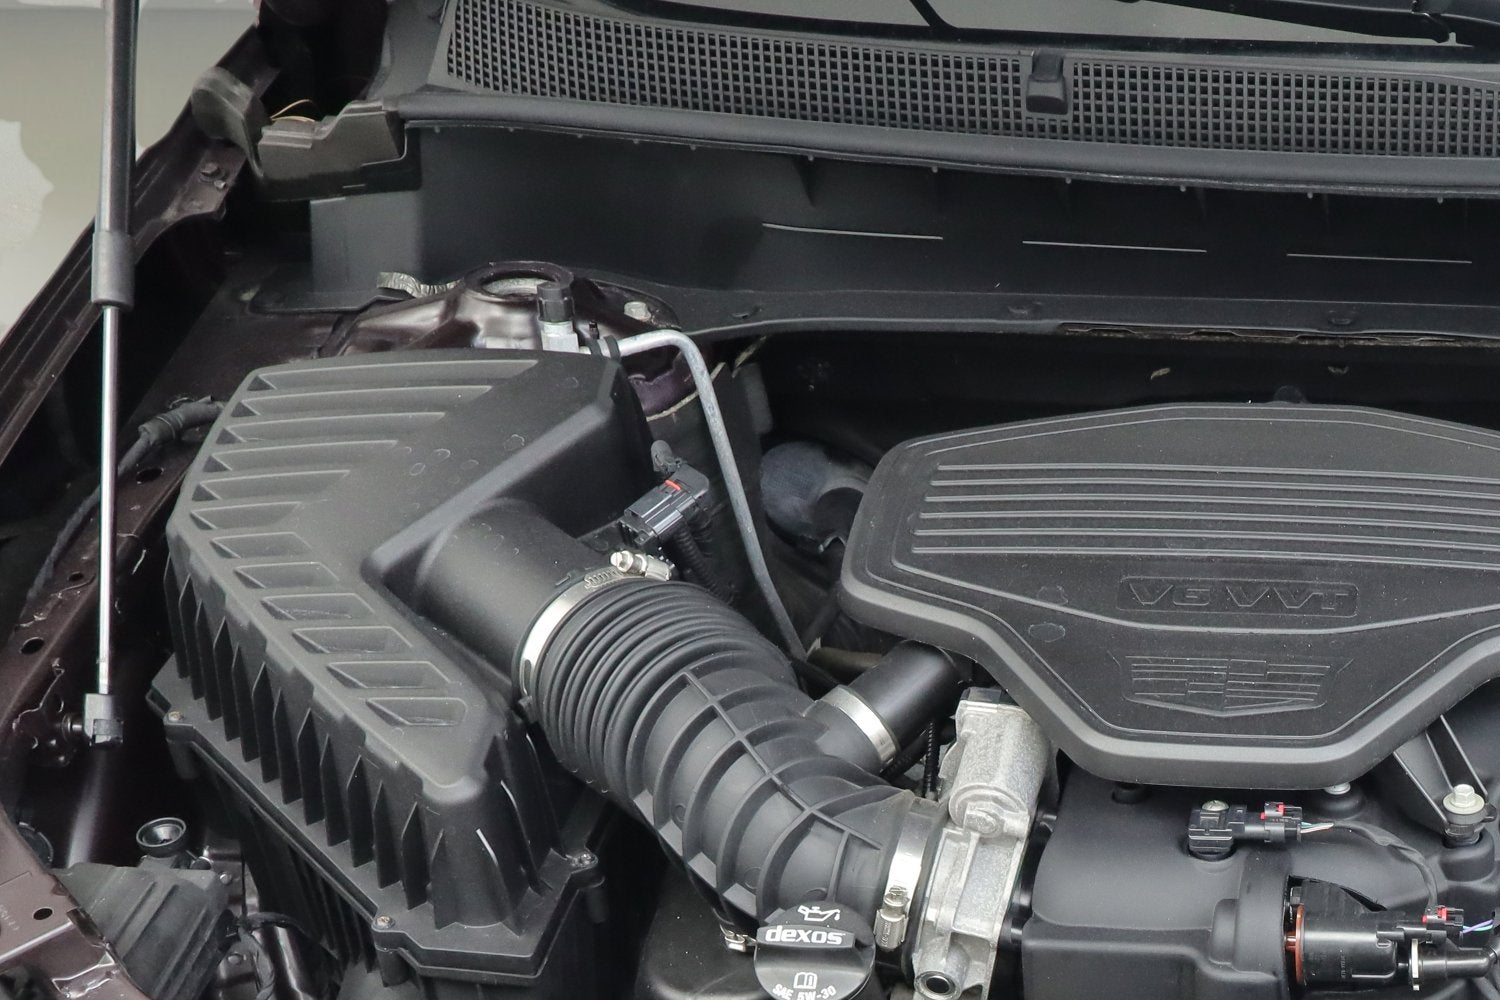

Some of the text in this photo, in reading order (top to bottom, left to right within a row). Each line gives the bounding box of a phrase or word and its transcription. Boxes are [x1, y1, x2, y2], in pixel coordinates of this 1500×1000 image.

[1128, 582, 1349, 611] V6 VVT
[765, 924, 843, 945] dexos
[772, 983, 794, 1000] SAE
